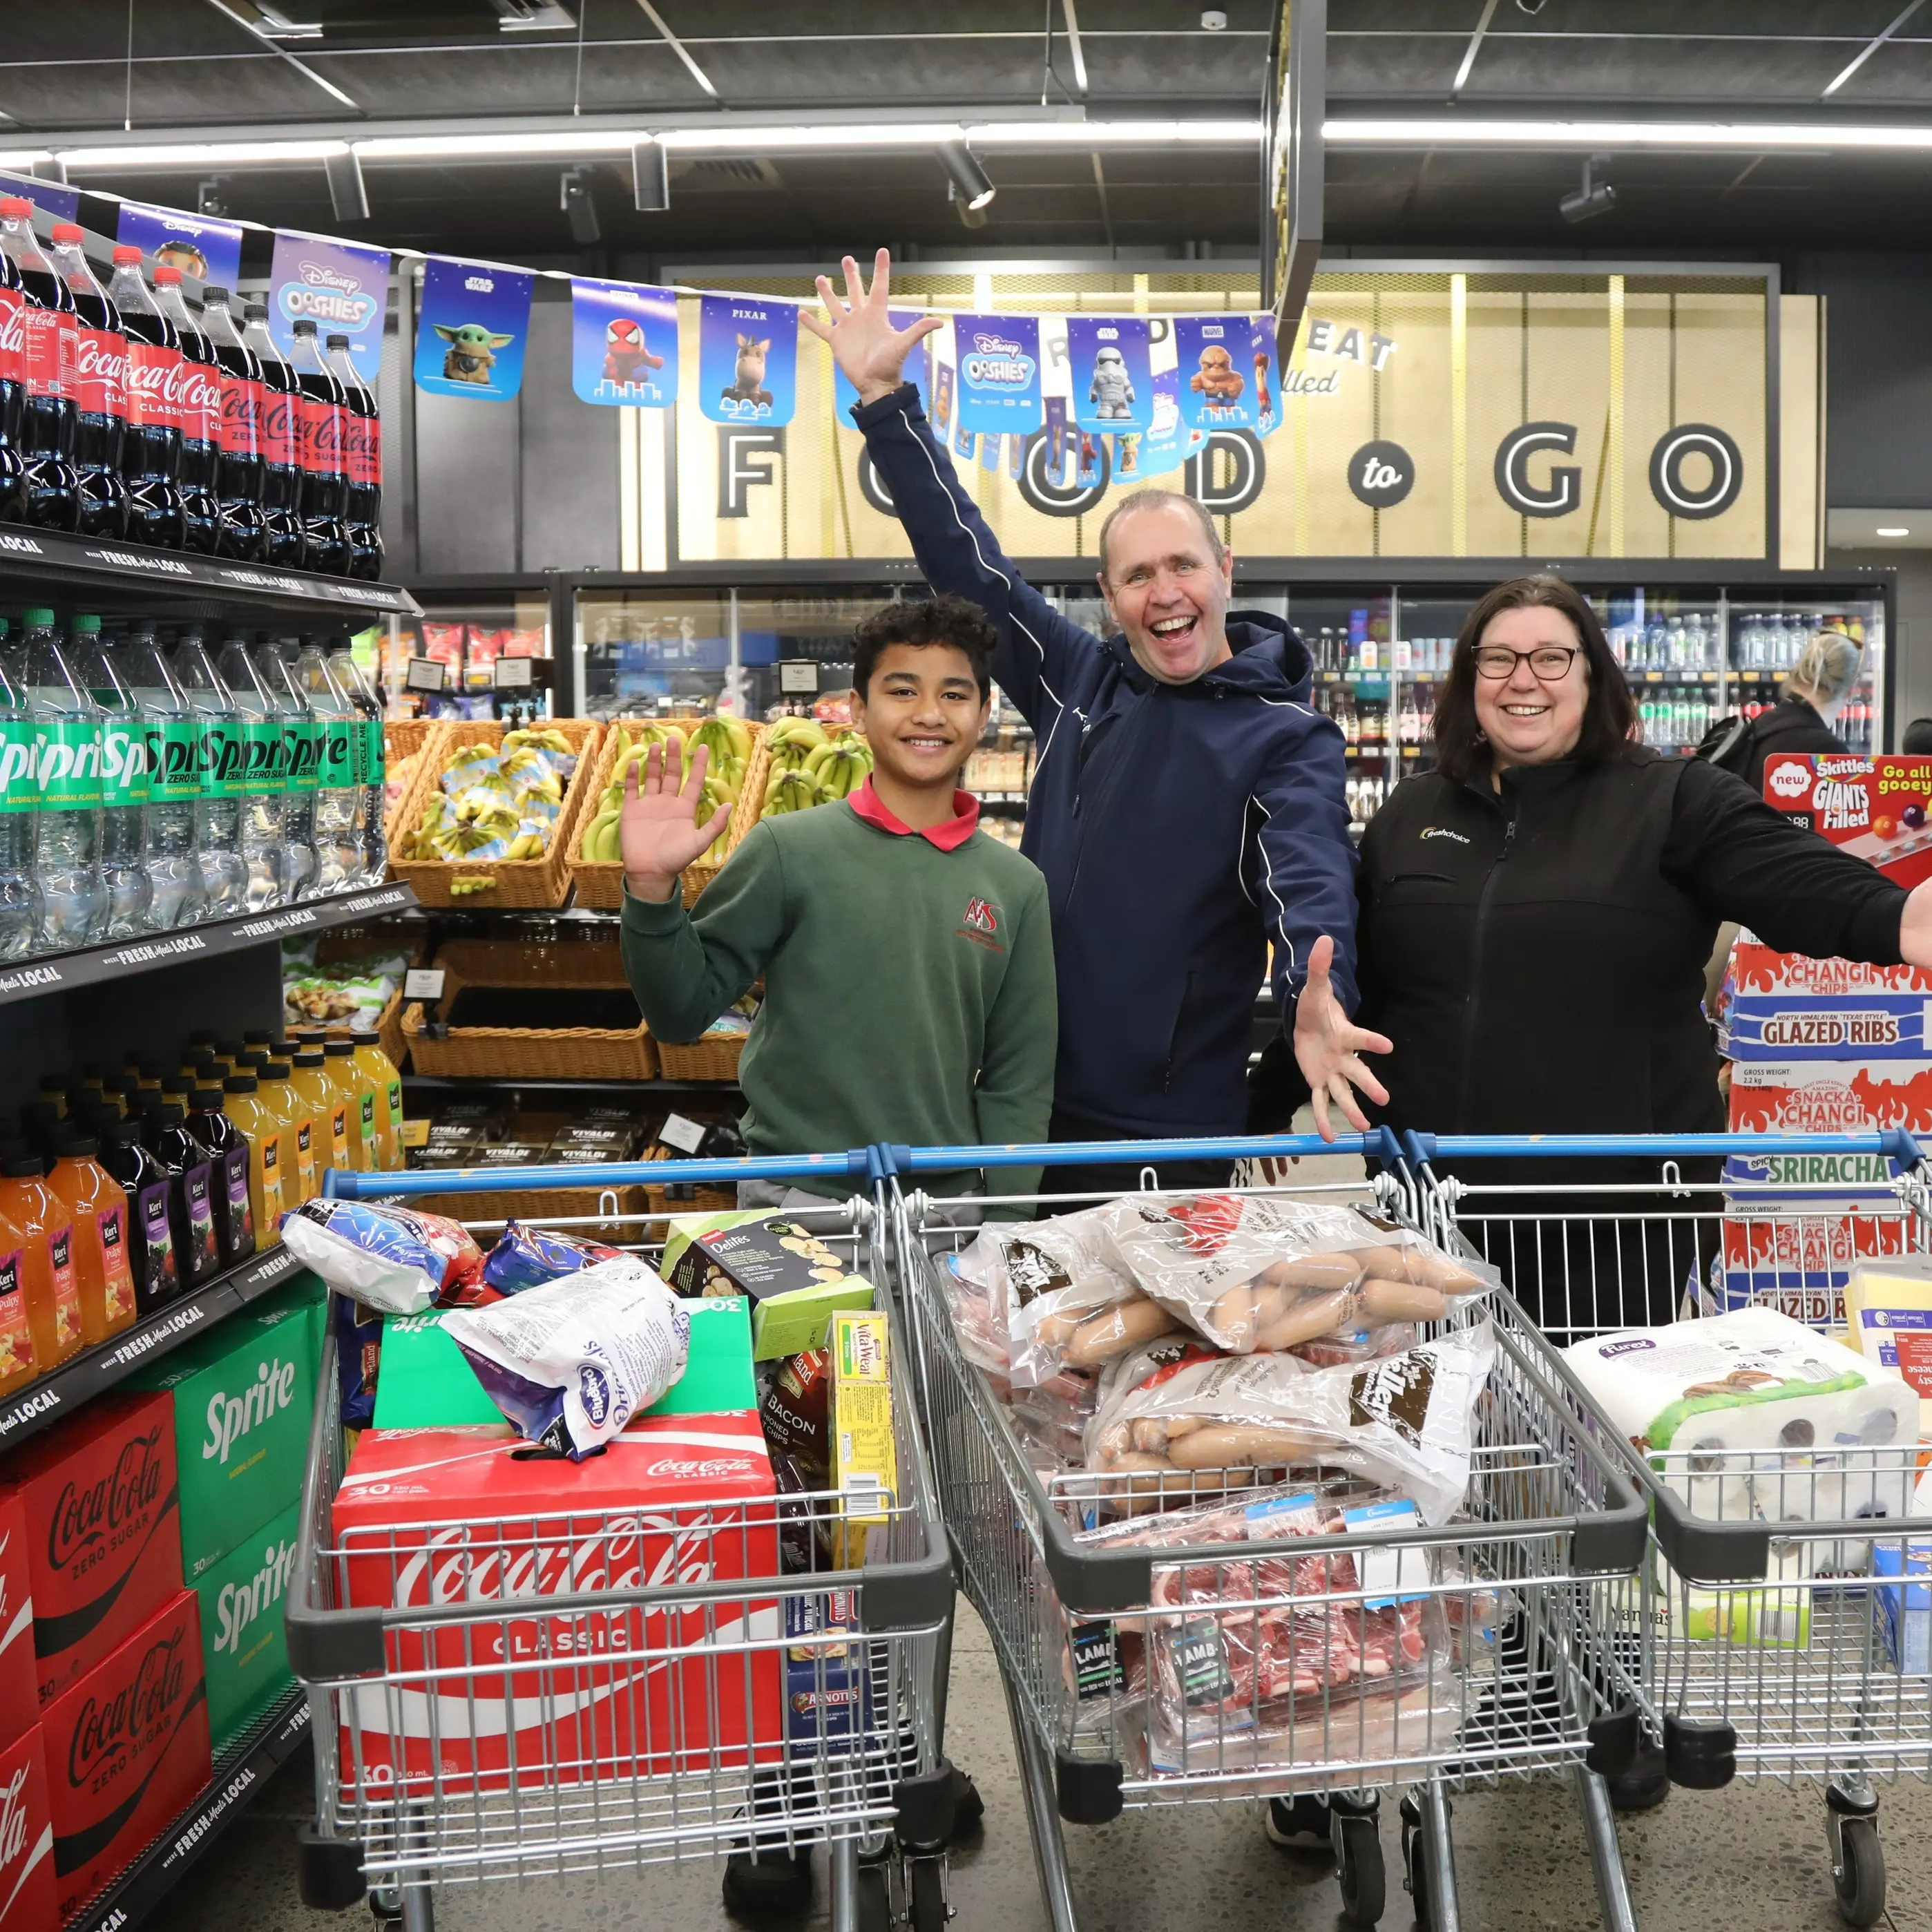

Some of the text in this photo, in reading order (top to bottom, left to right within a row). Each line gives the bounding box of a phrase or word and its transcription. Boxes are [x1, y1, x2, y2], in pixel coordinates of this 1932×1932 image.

[466, 282, 494, 293] WARS
[732, 309, 767, 321] PIXAR
[1203, 326, 1224, 337] MARVEL
[1308, 318, 1398, 371] EAT
[140, 403, 184, 417] CLASSIC
[232, 432, 260, 442] ZERO
[314, 450, 346, 463] SUGAR
[1362, 454, 1403, 489] to
[1493, 420, 1744, 520] GO
[0, 535, 44, 554] LOCAL
[100, 550, 140, 568] FRESH
[155, 558, 193, 575] LOCAL
[230, 571, 304, 591] FRESH LOCAL
[360, 723, 367, 739] ME
[247, 770, 270, 780] ZERO
[1816, 759, 1875, 778] Skittles
[1882, 765, 1931, 778] Go all
[166, 774, 189, 784] ZERO
[1776, 774, 1805, 786] new
[1812, 781, 1870, 810] GIANTS
[1878, 780, 1932, 796] gooey
[46, 794, 77, 803] NATURAL
[1823, 810, 1869, 830] Filled
[346, 890, 405, 912] FRESH LOCAL
[242, 919, 274, 937] FRESH
[285, 909, 317, 927] LOCAL
[117, 946, 157, 965] FRESH
[154, 945, 173, 959] Meets
[171, 935, 207, 954] LOCAL
[17, 966, 62, 988] LOCAL
[1790, 963, 1872, 984] CHANGI
[1811, 984, 1849, 995] CHIPS
[1763, 1020, 1897, 1045] GLAZED RIBS
[1754, 1076, 1762, 1085] kg
[1793, 1091, 1855, 1104] SNACKA
[1785, 1104, 1865, 1124] CHANGI
[571, 1129, 618, 1138] VIVALDI
[1804, 1124, 1843, 1133] CHIPS
[298, 1132, 310, 1145] Keri
[485, 1148, 531, 1158] VIVALDI
[561, 1149, 609, 1159] VIVALDI
[231, 1163, 242, 1176] Keri
[1750, 1155, 1775, 1169] SPICY
[1768, 1156, 1889, 1183] SRIRACHA
[192, 1181, 204, 1196] Keri
[149, 1200, 162, 1214] Keri
[104, 1224, 118, 1239] Keri
[710, 1234, 751, 1254] Delites
[54, 1245, 67, 1261] Keri
[106, 1246, 122, 1260] Pulpy
[258, 1254, 291, 1279] FRESH
[476, 1321, 488, 1332] CUT
[100, 1305, 205, 1370] WHERE FRESH Meets LOCAL
[1601, 1339, 1649, 1355] Purex
[17, 1388, 61, 1424] LOCAL
[202, 1357, 294, 1465] Sprite
[767, 1393, 816, 1435] BACON
[767, 1425, 788, 1446] CHIPS
[647, 1457, 758, 1477] Coca-Cola
[675, 1470, 729, 1479] CLASSIC
[48, 1419, 164, 1571] Coca-Cola
[348, 1484, 391, 1496] 30
[71, 1512, 150, 1580] ZERO SUGAR
[192, 1556, 207, 1576] 30
[392, 1510, 738, 1633] Coca-Cola
[492, 1629, 629, 1656] CLASSIC
[38, 1678, 56, 1705] 30
[68, 1625, 186, 1789] Coca-Cola
[280, 1726, 293, 1741] WHERE
[92, 1715, 173, 1795] ZERO SUGAR
[162, 1767, 256, 1868] WHERE FRESH Meets LOCAL
